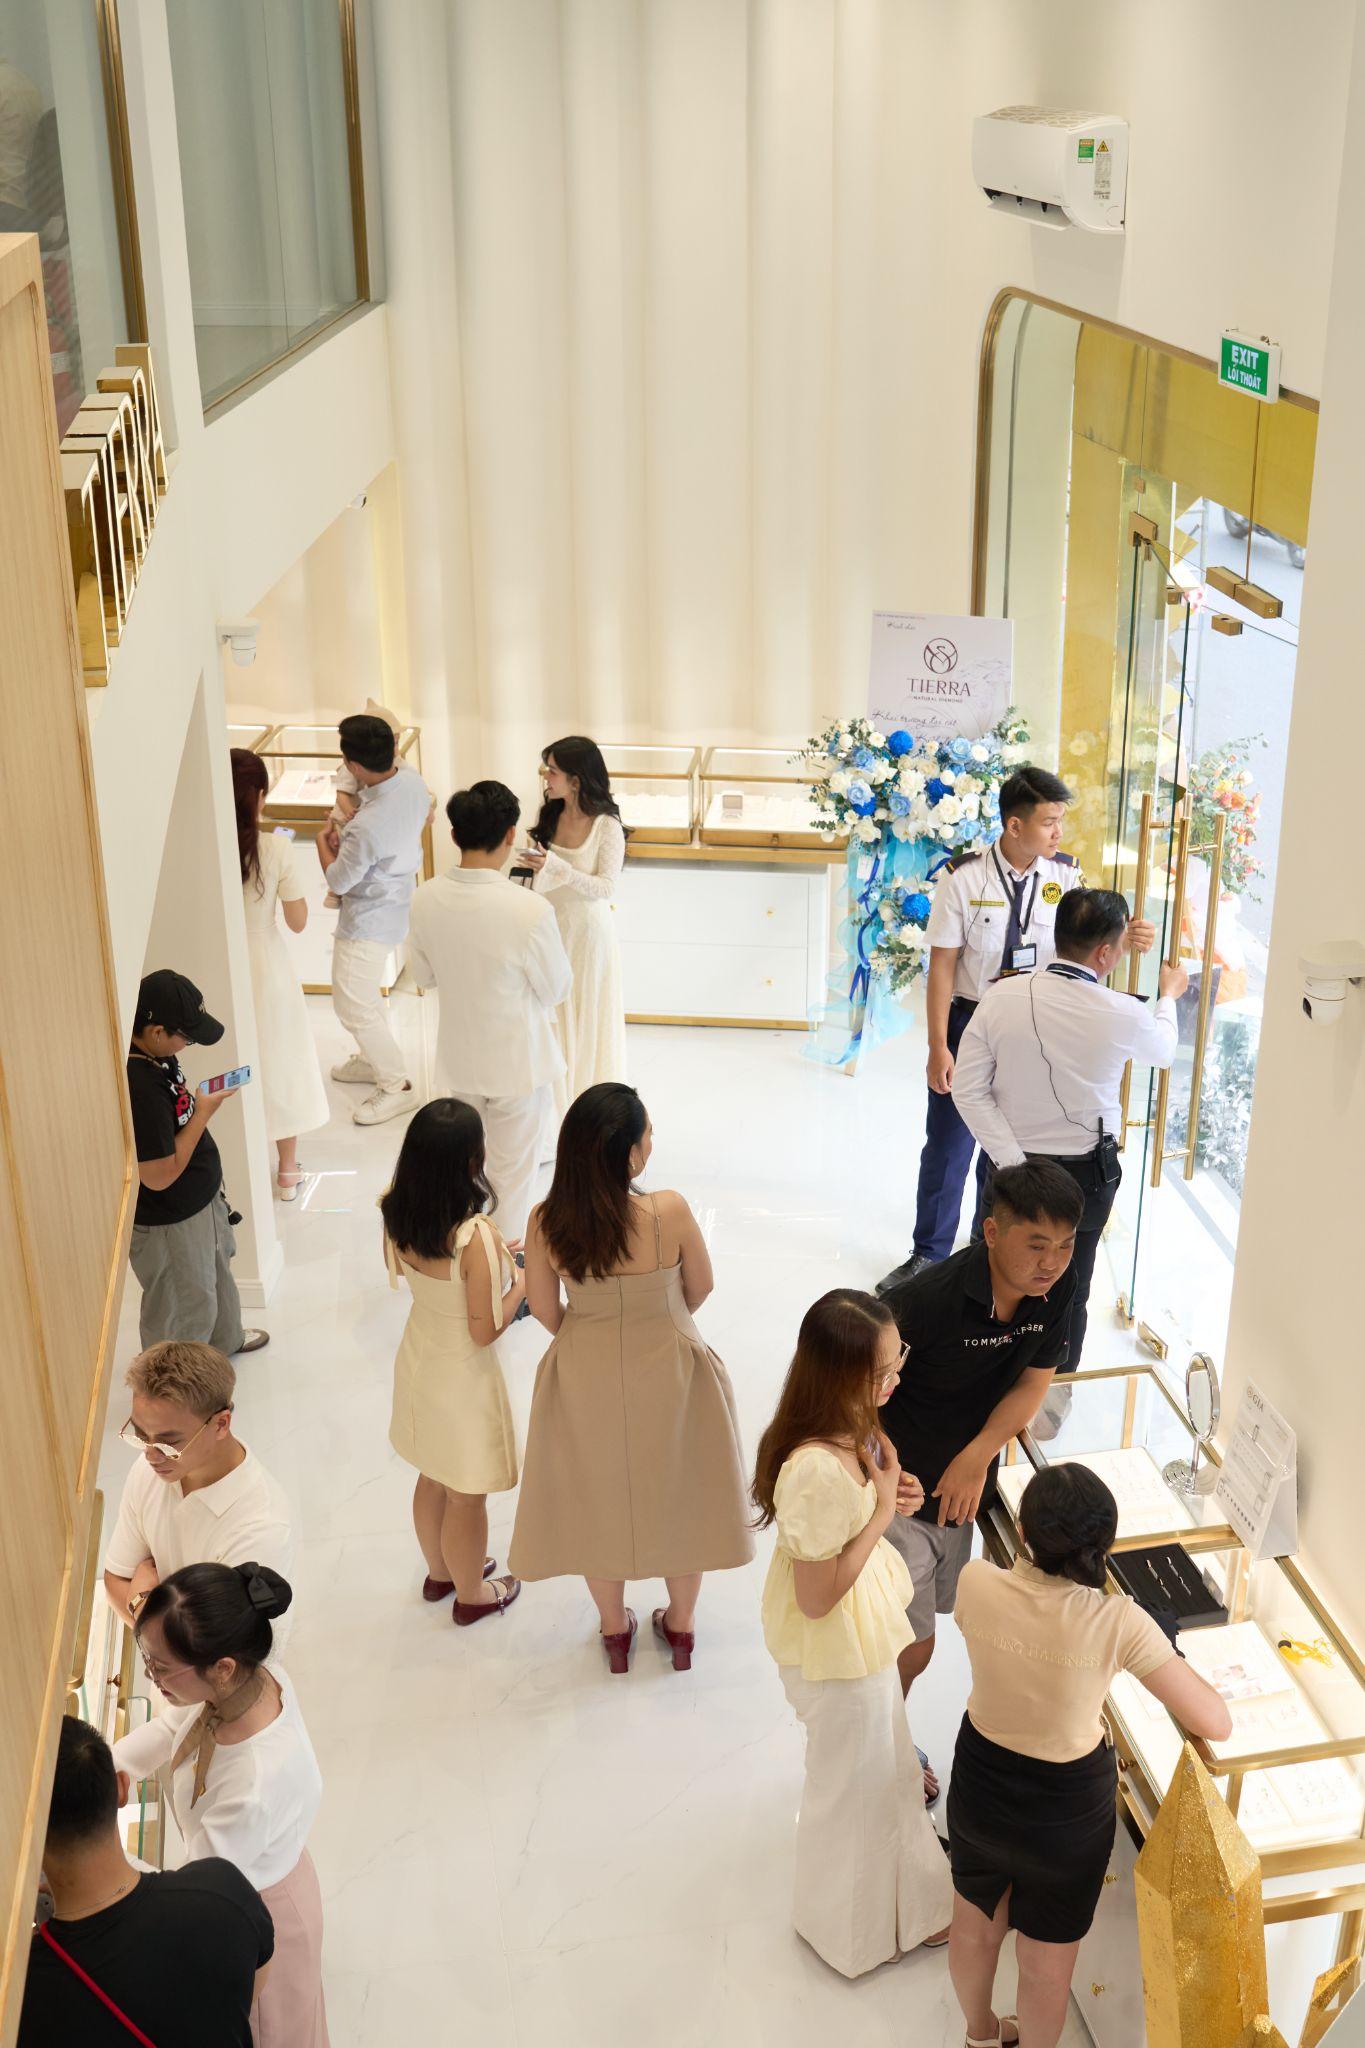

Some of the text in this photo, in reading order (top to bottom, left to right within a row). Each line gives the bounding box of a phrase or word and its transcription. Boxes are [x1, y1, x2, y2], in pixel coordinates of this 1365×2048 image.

[1231, 345, 1259, 370] EXIT
[1240, 370, 1262, 390] THOÁT
[907, 678, 971, 697] TIERRA
